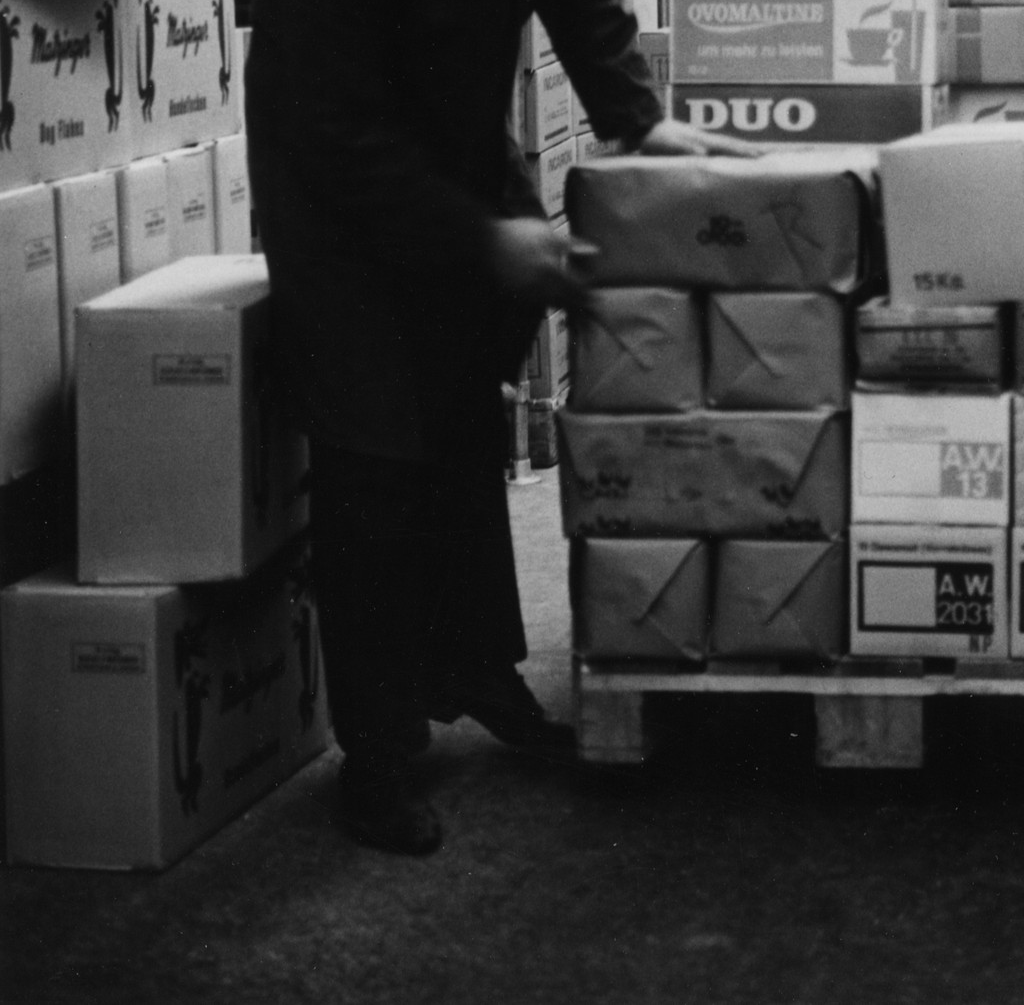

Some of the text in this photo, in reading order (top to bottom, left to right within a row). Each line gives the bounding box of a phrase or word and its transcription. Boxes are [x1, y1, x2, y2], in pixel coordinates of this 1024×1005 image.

[687, 2, 824, 23] OVOMALTINE
[685, 98, 816, 131] DUO
[957, 471, 987, 497] 13
[938, 601, 993, 625] 2031
[969, 635, 992, 654] NP
